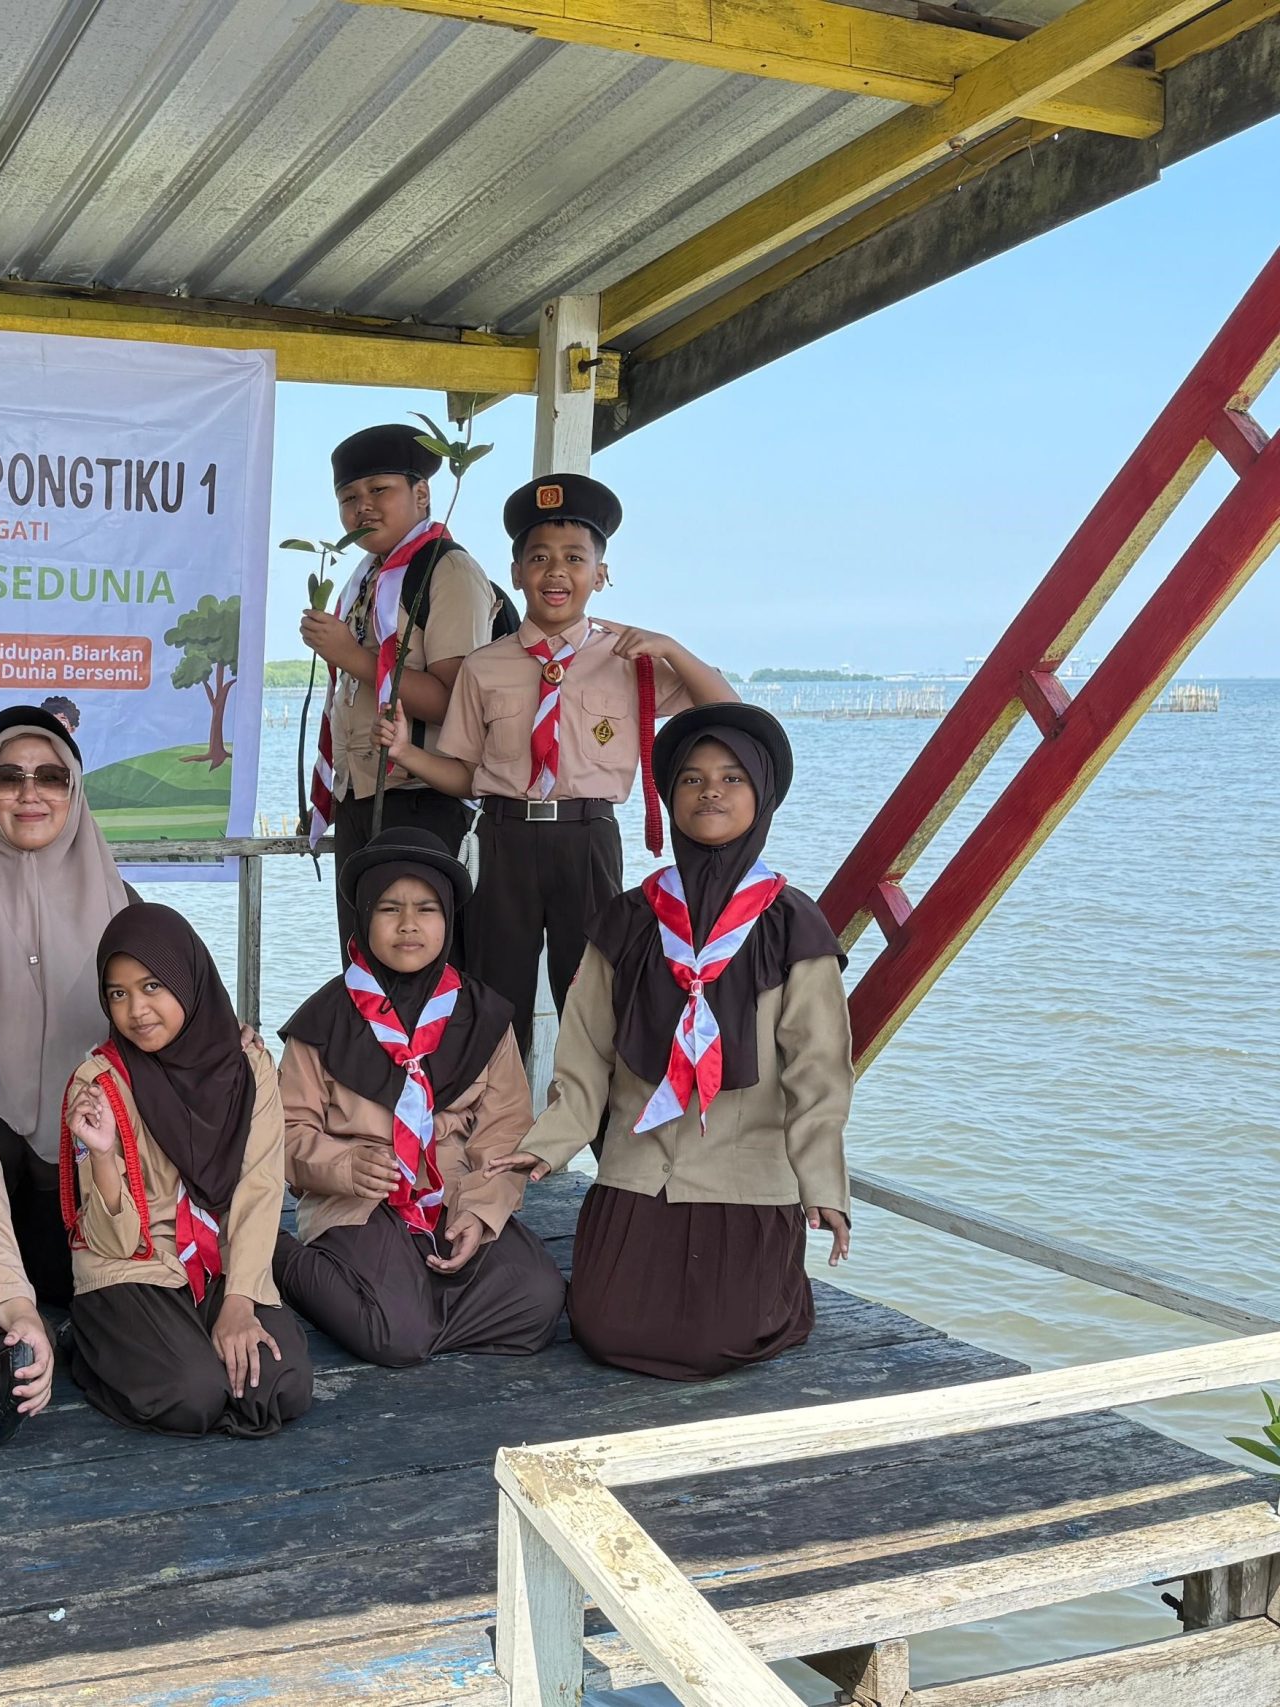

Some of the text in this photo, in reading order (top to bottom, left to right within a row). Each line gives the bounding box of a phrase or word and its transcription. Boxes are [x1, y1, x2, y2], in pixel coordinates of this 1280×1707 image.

[199, 463, 217, 515] 1
[1, 663, 57, 680] Dunia
[63, 664, 144, 682] Bersemi.
